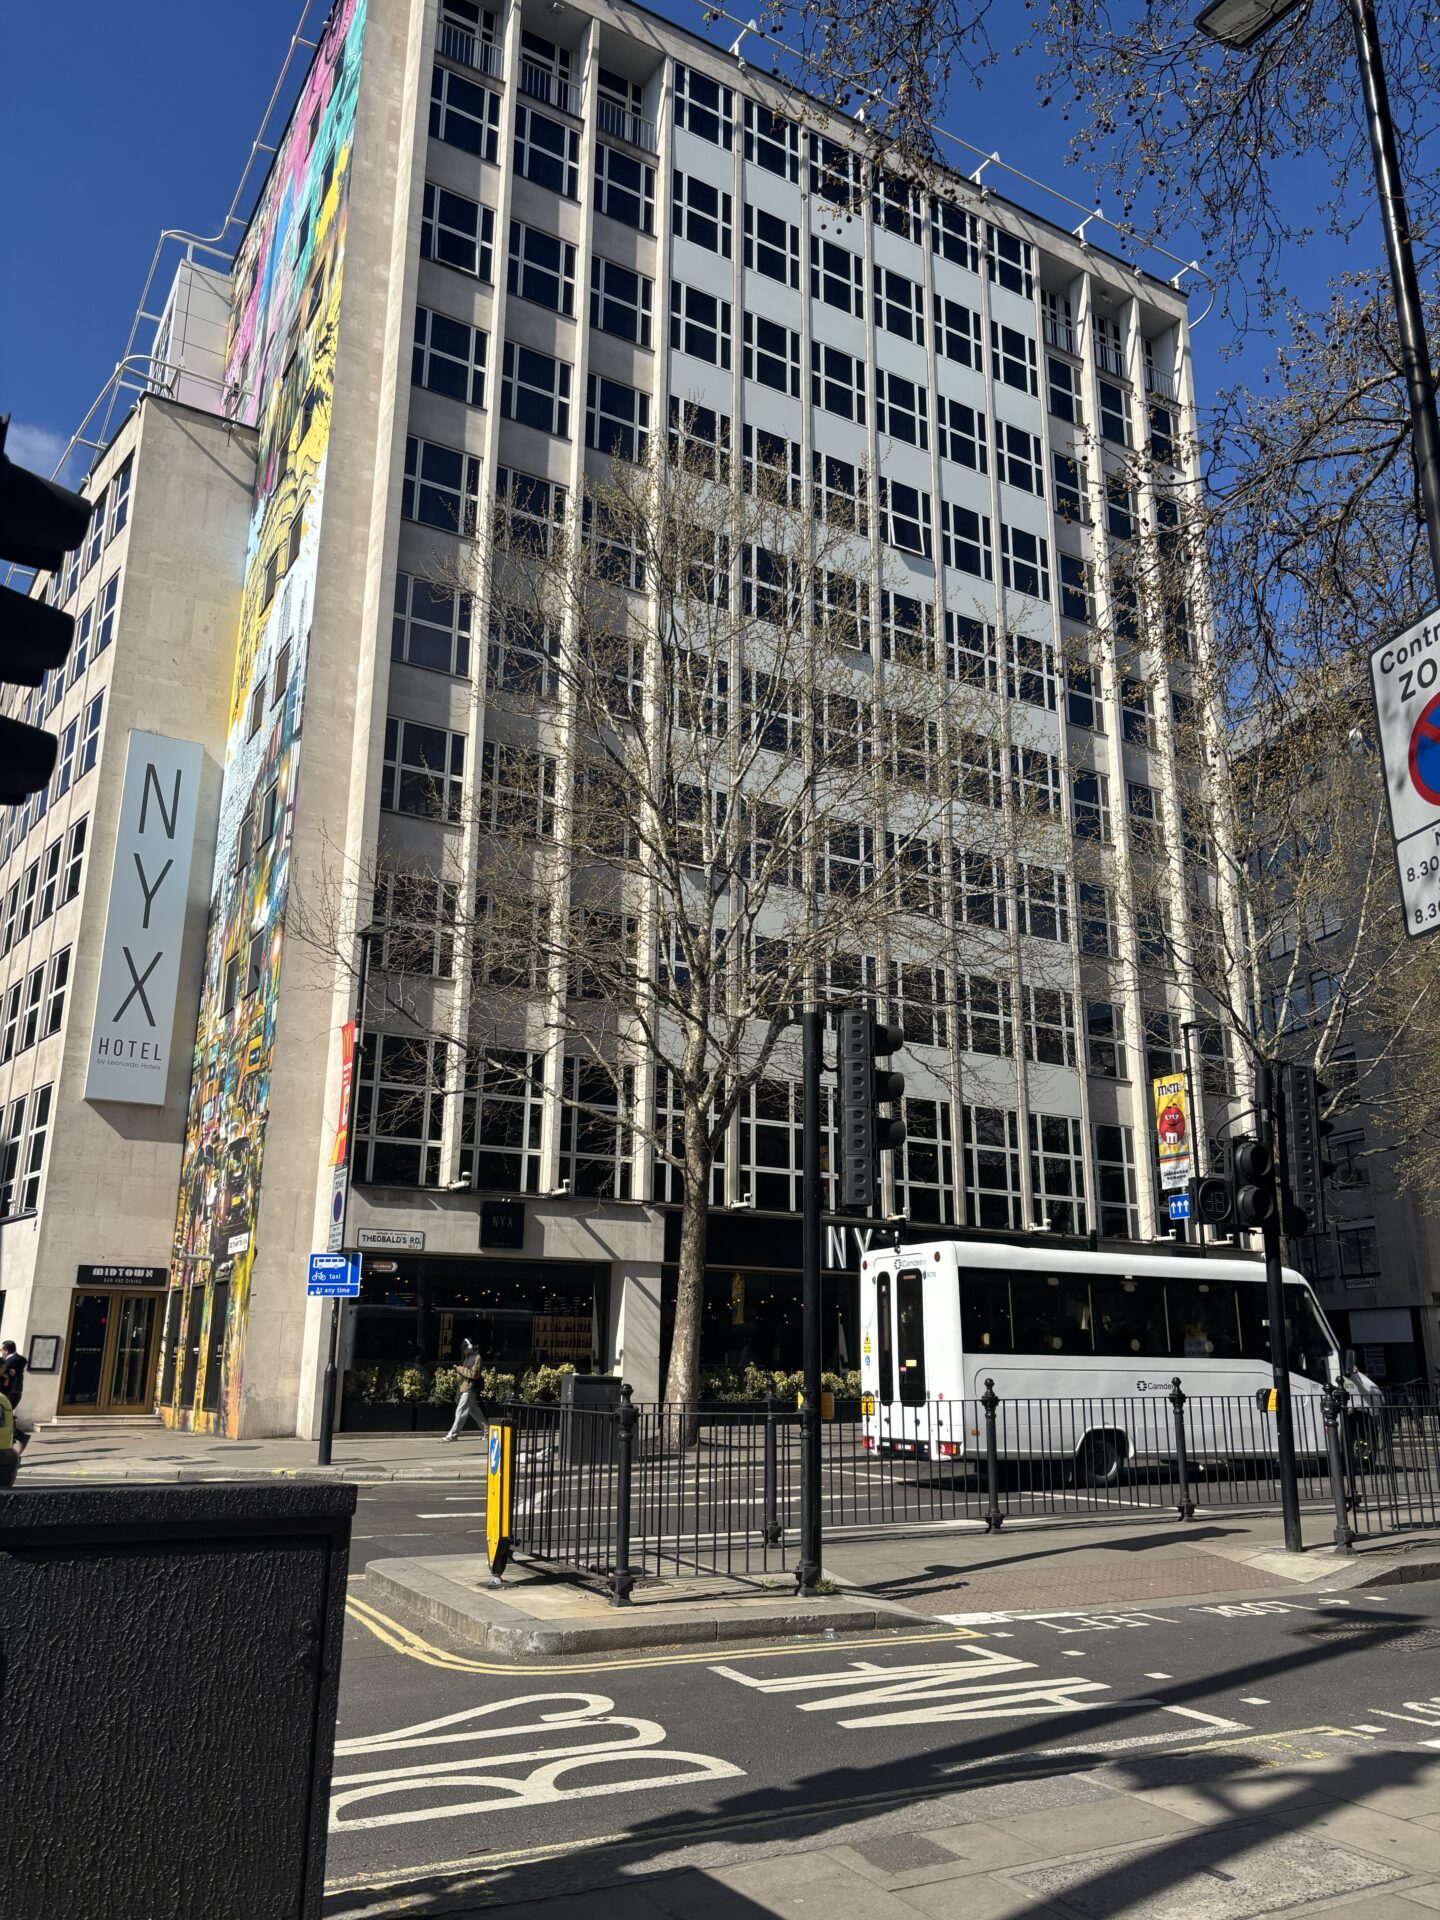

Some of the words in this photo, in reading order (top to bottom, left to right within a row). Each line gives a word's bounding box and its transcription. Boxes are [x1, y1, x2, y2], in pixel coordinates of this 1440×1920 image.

[1407, 856, 1439, 882] 8.30
[112, 763, 182, 1027] NYX
[1415, 903, 1440, 924] 8.3
[98, 1037, 162, 1061] HOTEL
[492, 1215, 513, 1228] NYX
[361, 1234, 407, 1244] THEOBALD'S
[409, 1237, 422, 1245] RD.
[826, 1225, 873, 1269] NY
[92, 1267, 154, 1278] MIDTOWN
[902, 1259, 924, 1268] Camden
[1035, 1612, 1181, 1634] LEFT
[707, 1644, 1253, 1774] LANE
[328, 1692, 748, 1833] BUS
